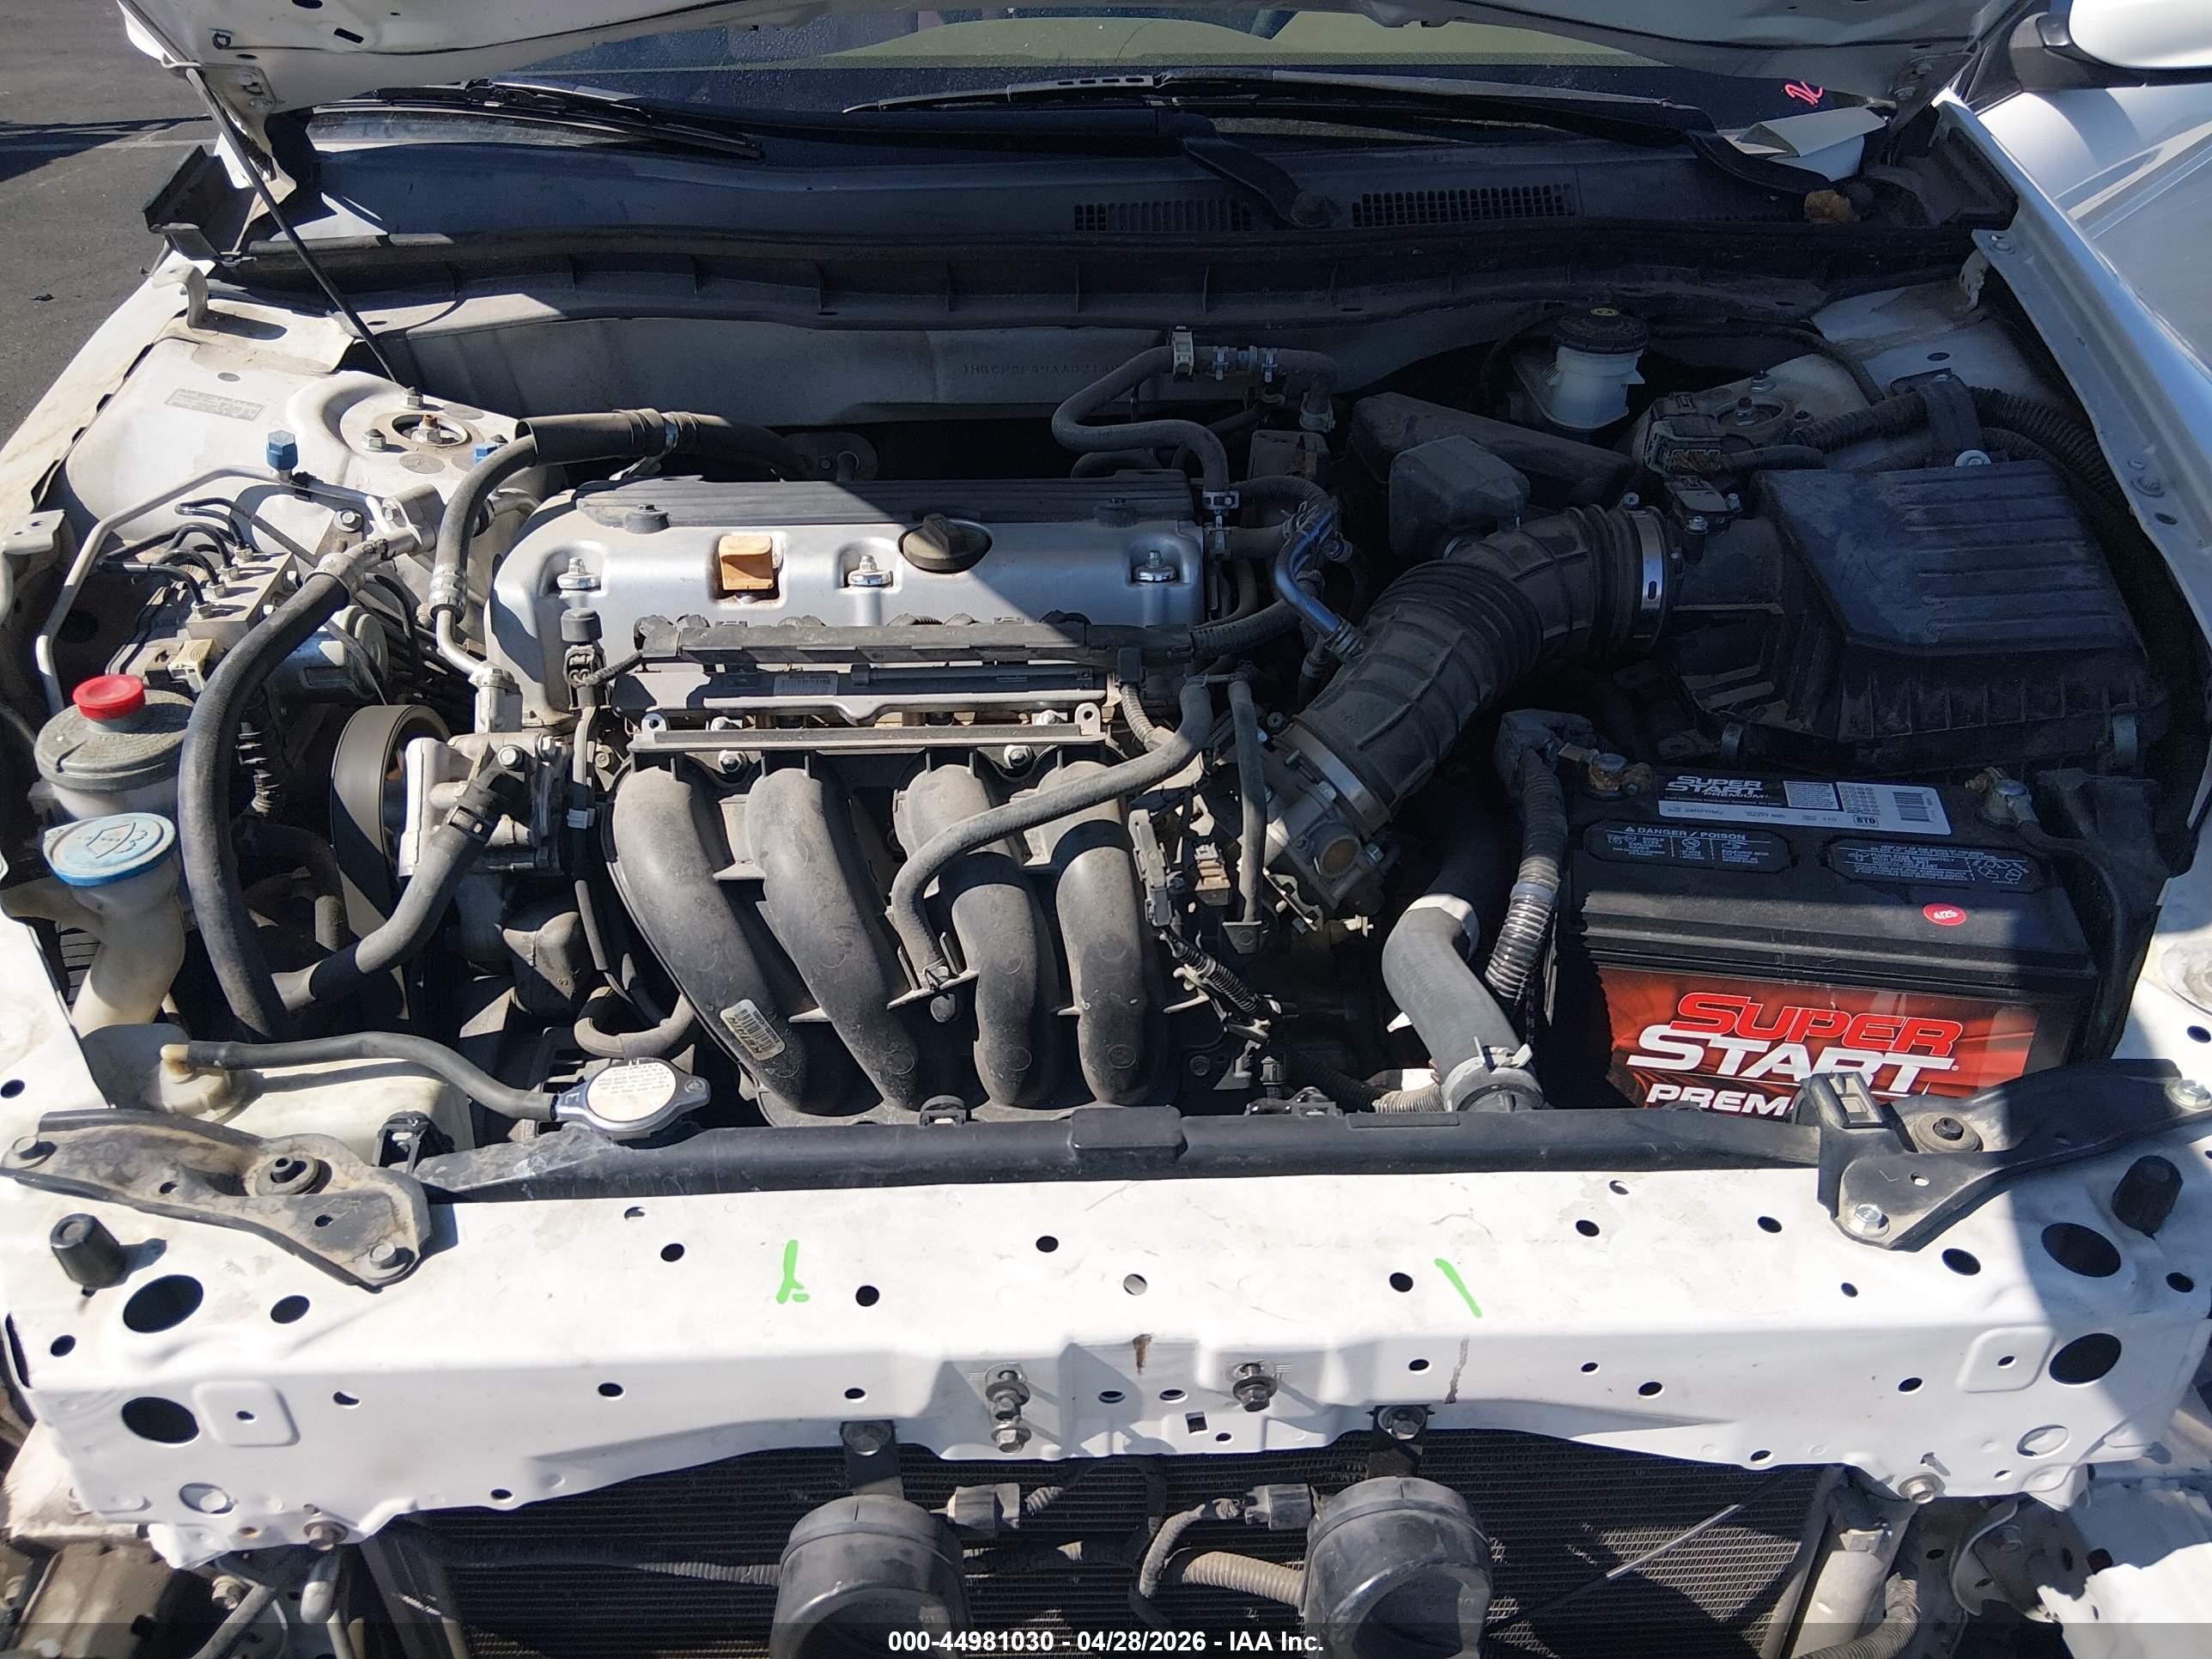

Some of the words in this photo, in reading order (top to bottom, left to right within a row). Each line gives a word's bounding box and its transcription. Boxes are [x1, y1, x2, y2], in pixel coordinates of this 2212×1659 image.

[1665, 781, 1763, 793] START
[1674, 775, 1761, 788] SUPER
[1638, 827, 1686, 836] DANGER
[1700, 831, 1746, 841] POISON
[1670, 993, 1961, 1056] SUPER
[1626, 1024, 1954, 1094] START
